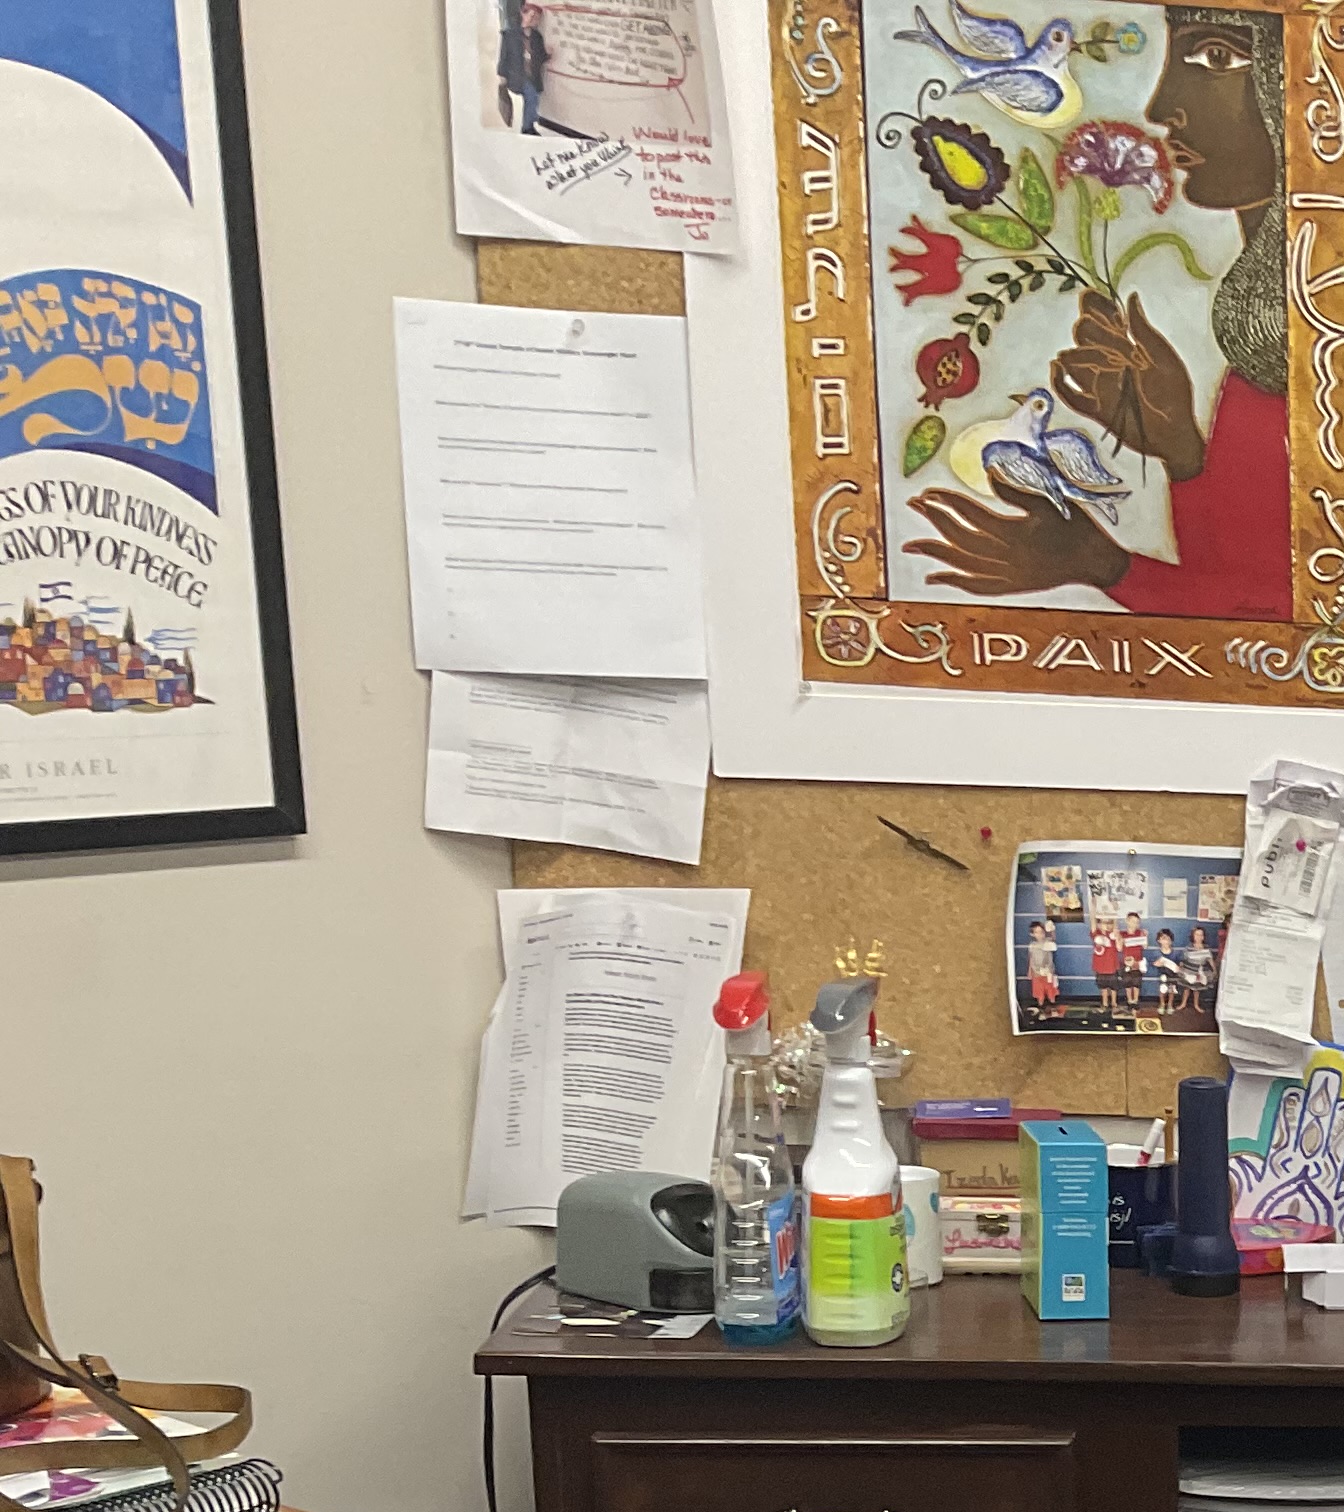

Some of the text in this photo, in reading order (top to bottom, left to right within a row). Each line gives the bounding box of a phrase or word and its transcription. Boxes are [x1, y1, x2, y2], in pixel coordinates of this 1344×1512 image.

[24, 480, 56, 514] OF
[96, 535, 131, 570] OF
[130, 545, 208, 608] PEACE
[970, 631, 1213, 678] PAIX
[26, 758, 118, 778] ISRAEL
